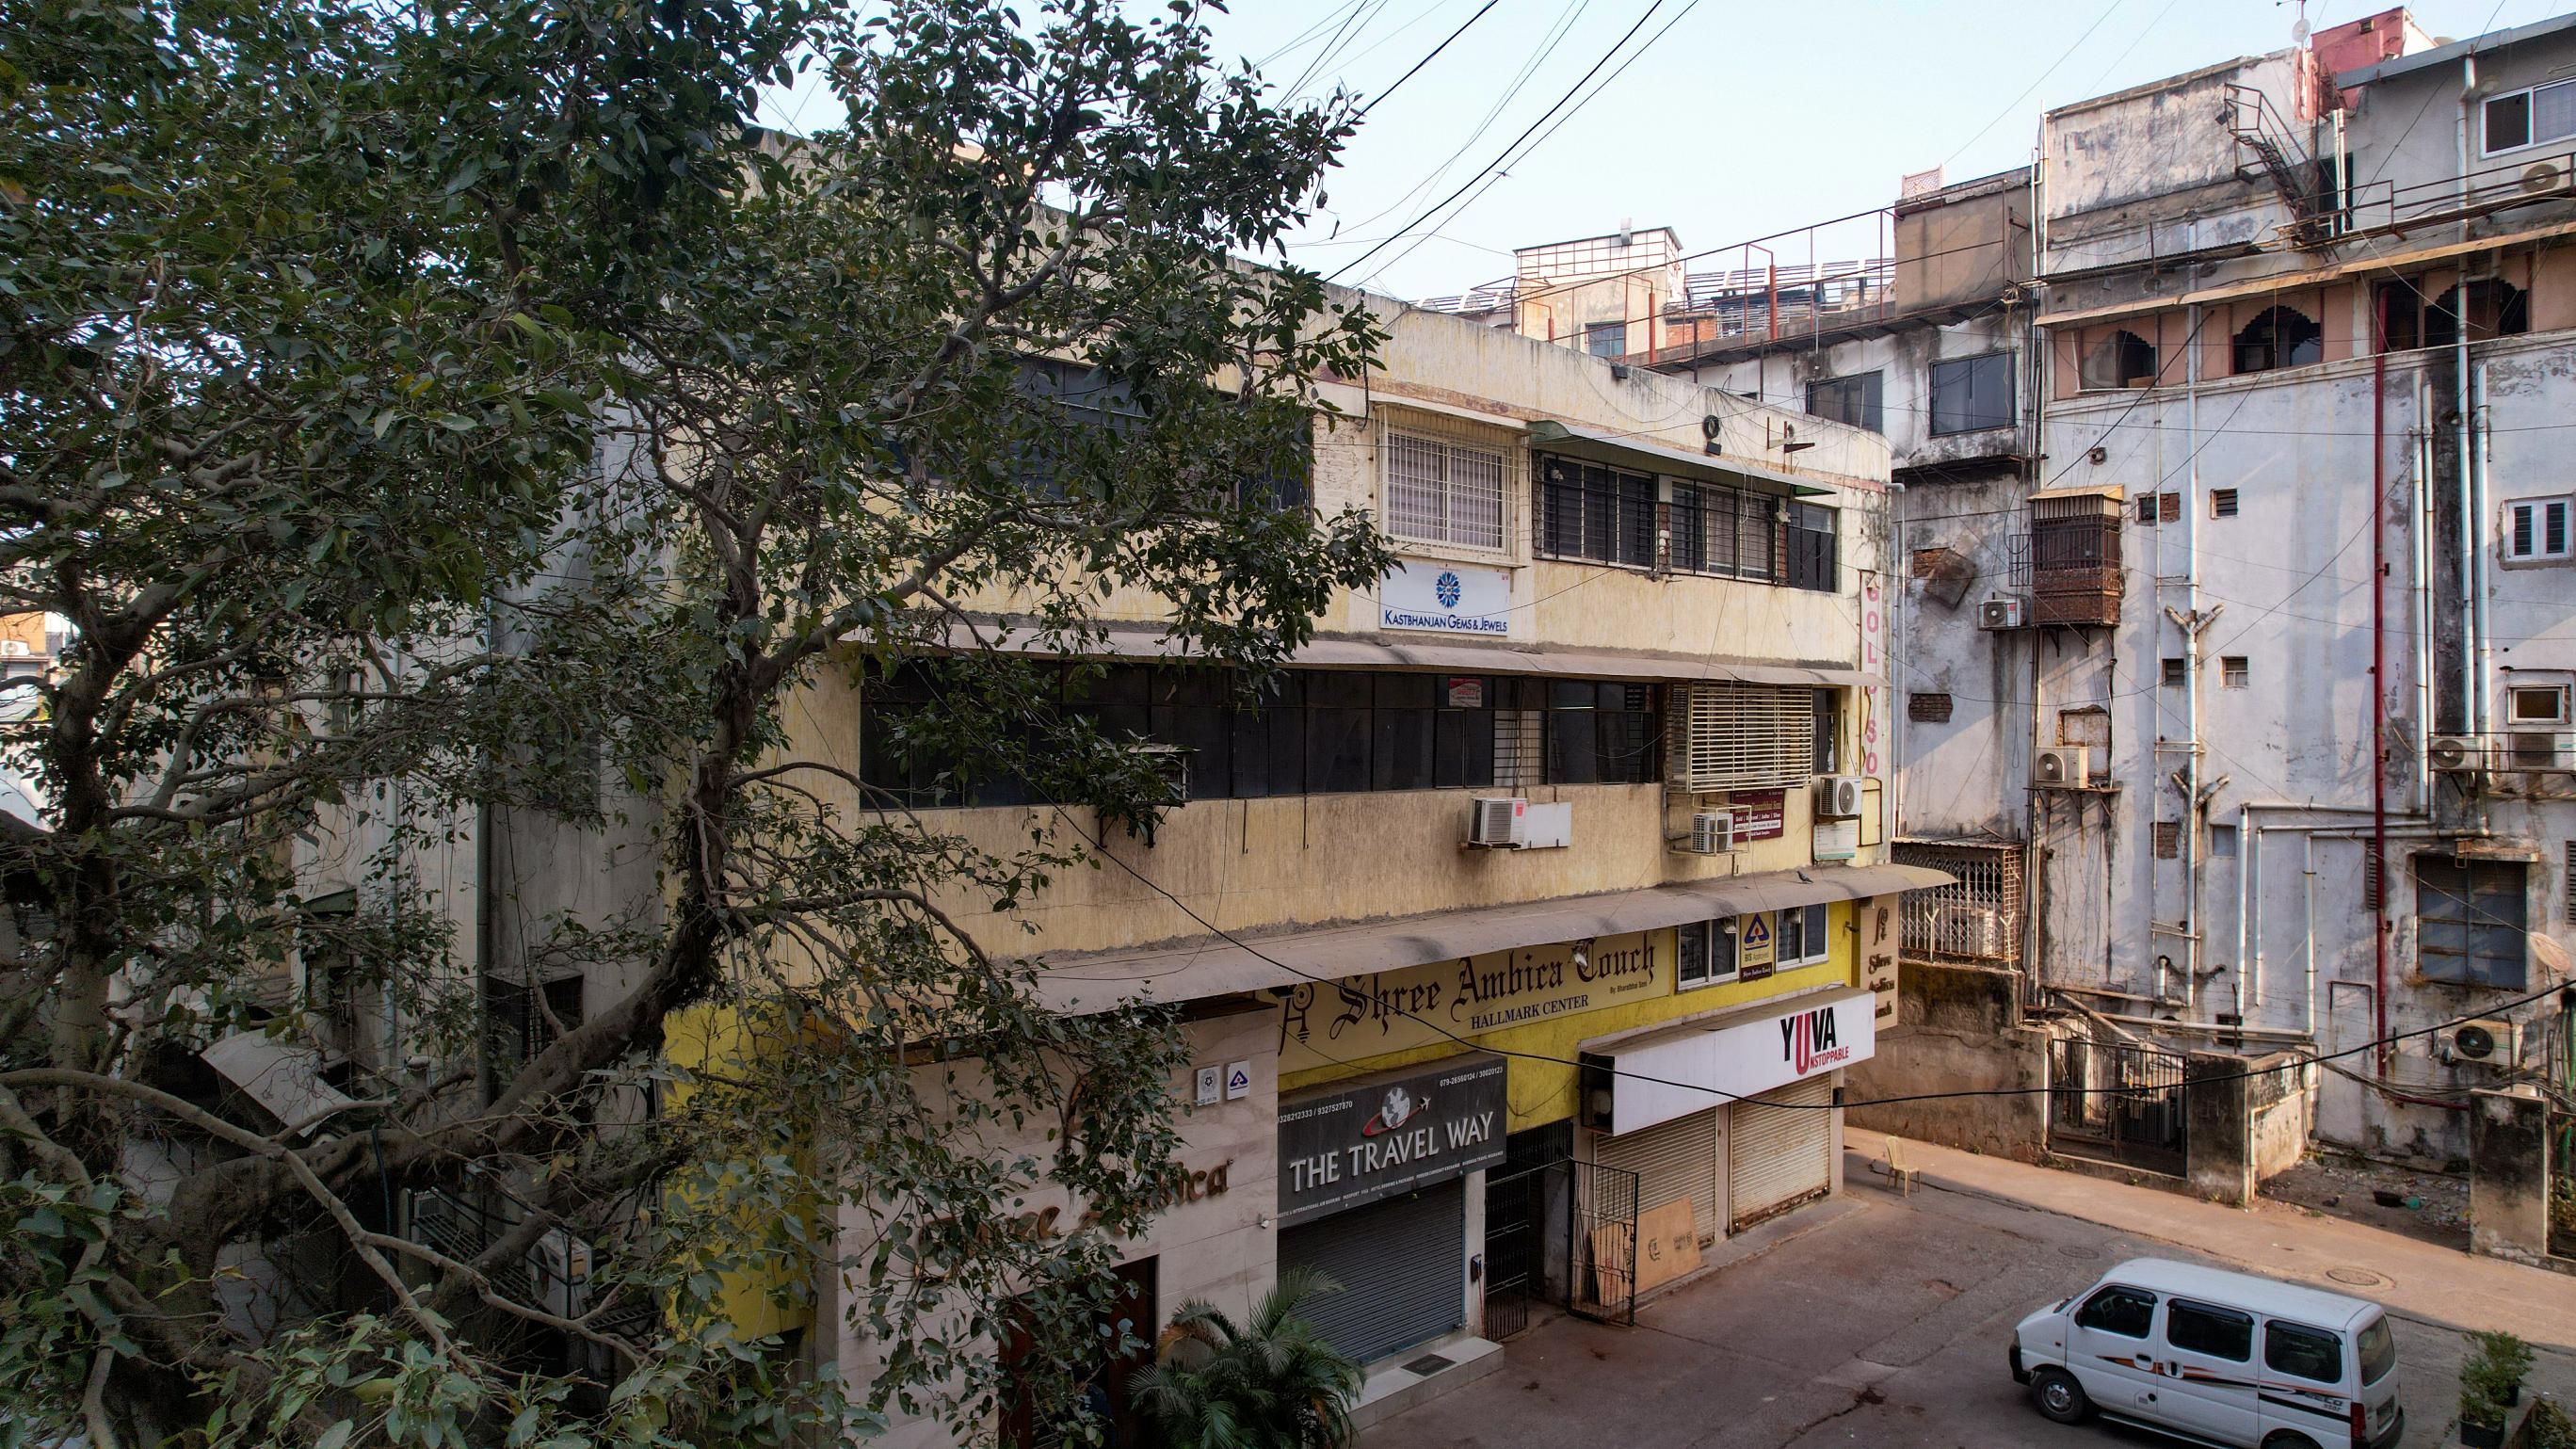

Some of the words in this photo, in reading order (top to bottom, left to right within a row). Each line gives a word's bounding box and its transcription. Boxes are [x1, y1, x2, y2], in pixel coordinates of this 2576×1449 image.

[1385, 610, 1446, 628] KASTBHANJAN
[1448, 614, 1473, 630] GEMS
[1473, 620, 1478, 631] &
[1479, 617, 1507, 632] JEWELS
[1329, 973, 1441, 1039] Shree
[1451, 949, 1563, 1022] Ambica
[1471, 1003, 1540, 1030] HALLMARK
[1542, 994, 1588, 1016] CENTER
[1780, 1006, 1837, 1075] YUVA
[1289, 1151, 1341, 1192] THE
[1347, 1127, 1440, 1177] TRAVEL
[1446, 1111, 1493, 1150] WAY
